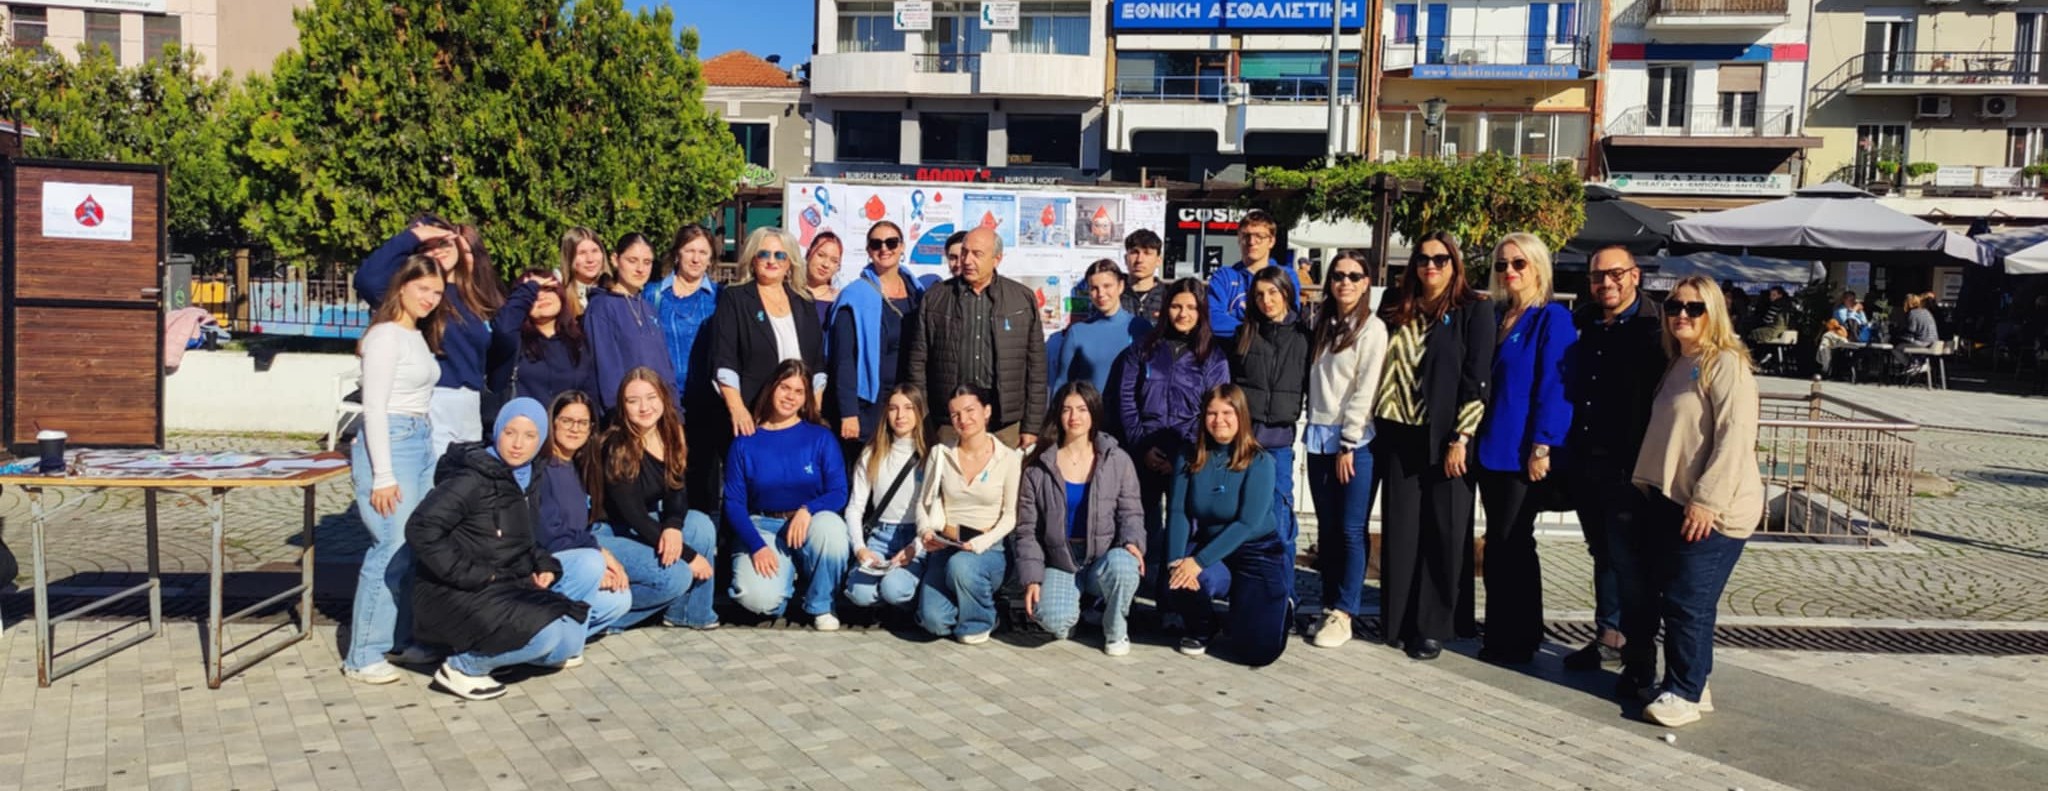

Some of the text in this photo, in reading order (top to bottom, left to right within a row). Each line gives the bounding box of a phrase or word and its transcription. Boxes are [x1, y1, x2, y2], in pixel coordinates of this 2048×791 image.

[1121, 2, 1357, 19] ΕΘΝΙΚΗ ΑΣΦΑΛΙΣΤΙΚΗ
[845, 171, 874, 180] BURGER
[1178, 208, 1264, 223] COSM
